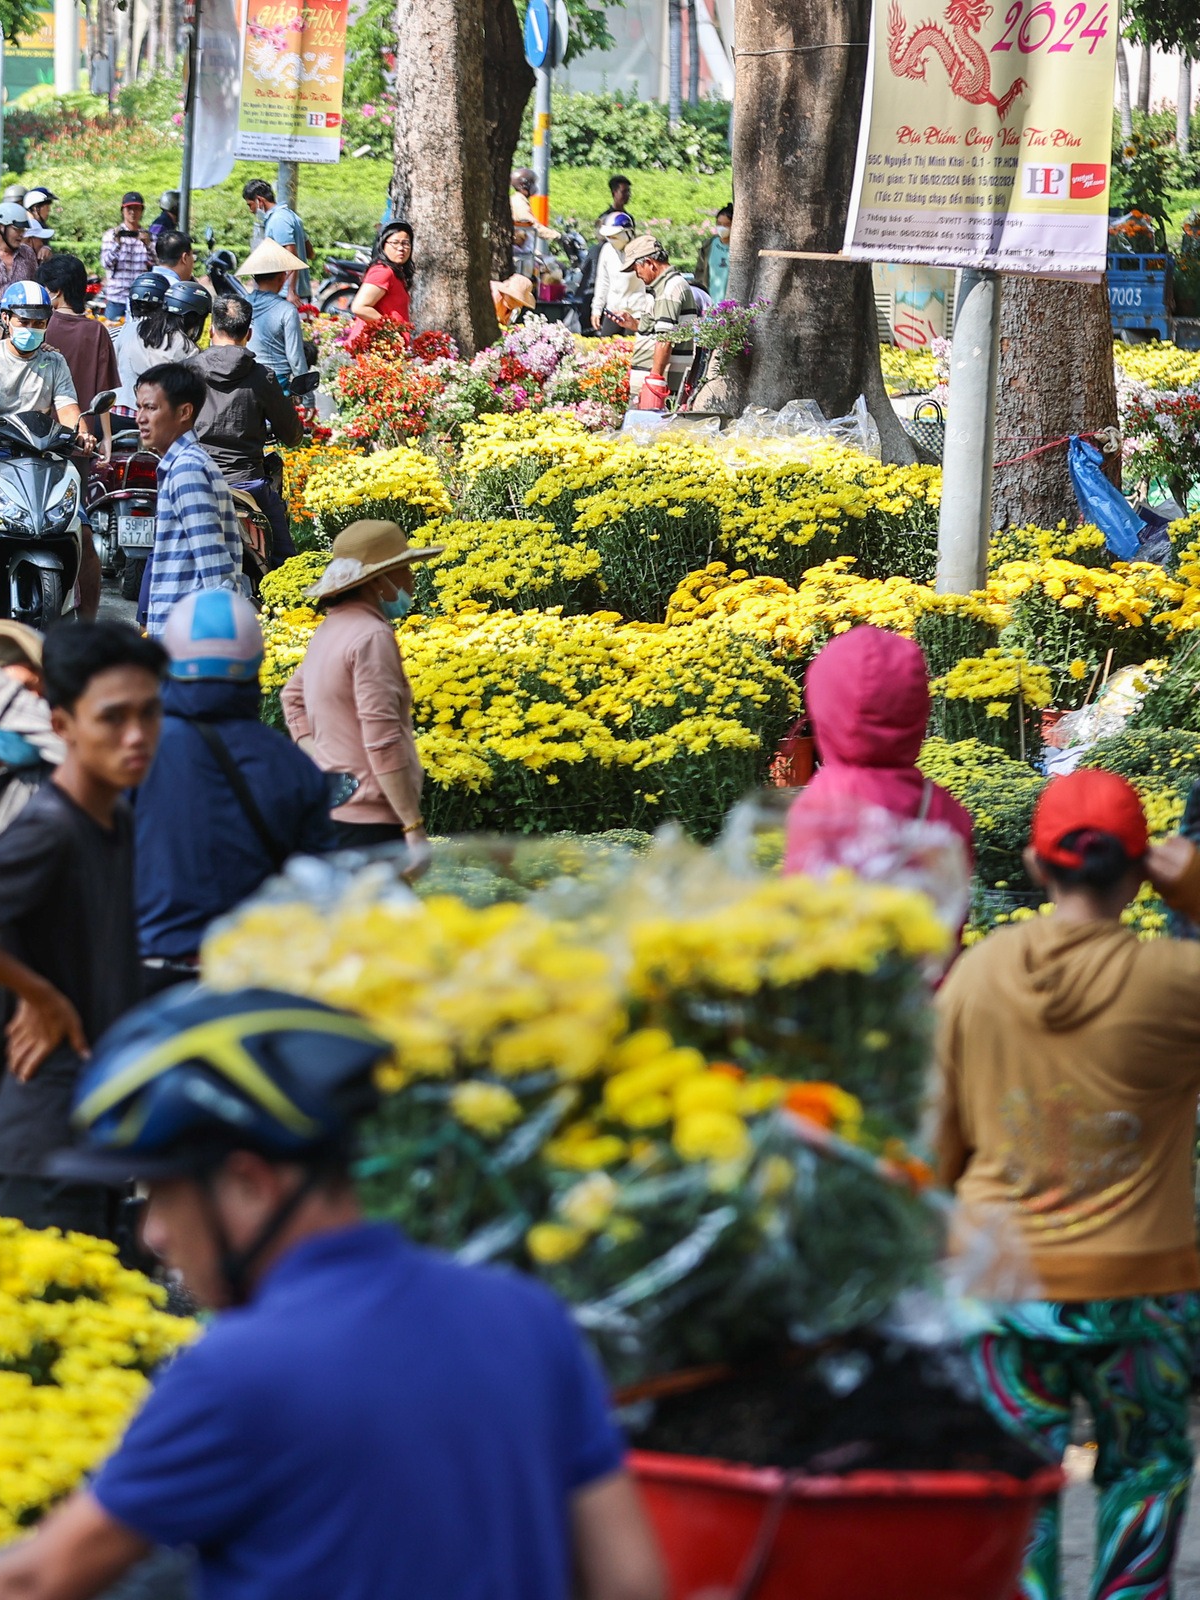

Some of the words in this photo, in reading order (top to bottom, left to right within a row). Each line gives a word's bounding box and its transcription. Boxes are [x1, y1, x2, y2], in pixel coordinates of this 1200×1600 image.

[256, 1, 298, 27] GIÁP
[300, 4, 342, 29] THÌN
[989, 1, 1109, 55] 2024
[309, 30, 345, 47] 2024
[895, 125, 921, 147] Địa
[923, 125, 961, 146] Điểm:
[964, 126, 995, 153] Công
[996, 127, 1020, 148] Viên
[1023, 127, 1049, 147] Tao
[1050, 128, 1082, 148] Đàn
[884, 153, 913, 168] Nguyễn
[914, 155, 926, 168] Thị
[928, 155, 947, 166] Minh
[948, 155, 965, 167] Khai
[971, 156, 984, 167] Q.1
[868, 172, 885, 184] Thời
[908, 173, 918, 185] Từ
[919, 173, 960, 186] 06/02/2024
[893, 191, 904, 203] 27
[905, 192, 927, 206] tháng
[928, 192, 947, 206] chạp
[949, 192, 963, 205] đến
